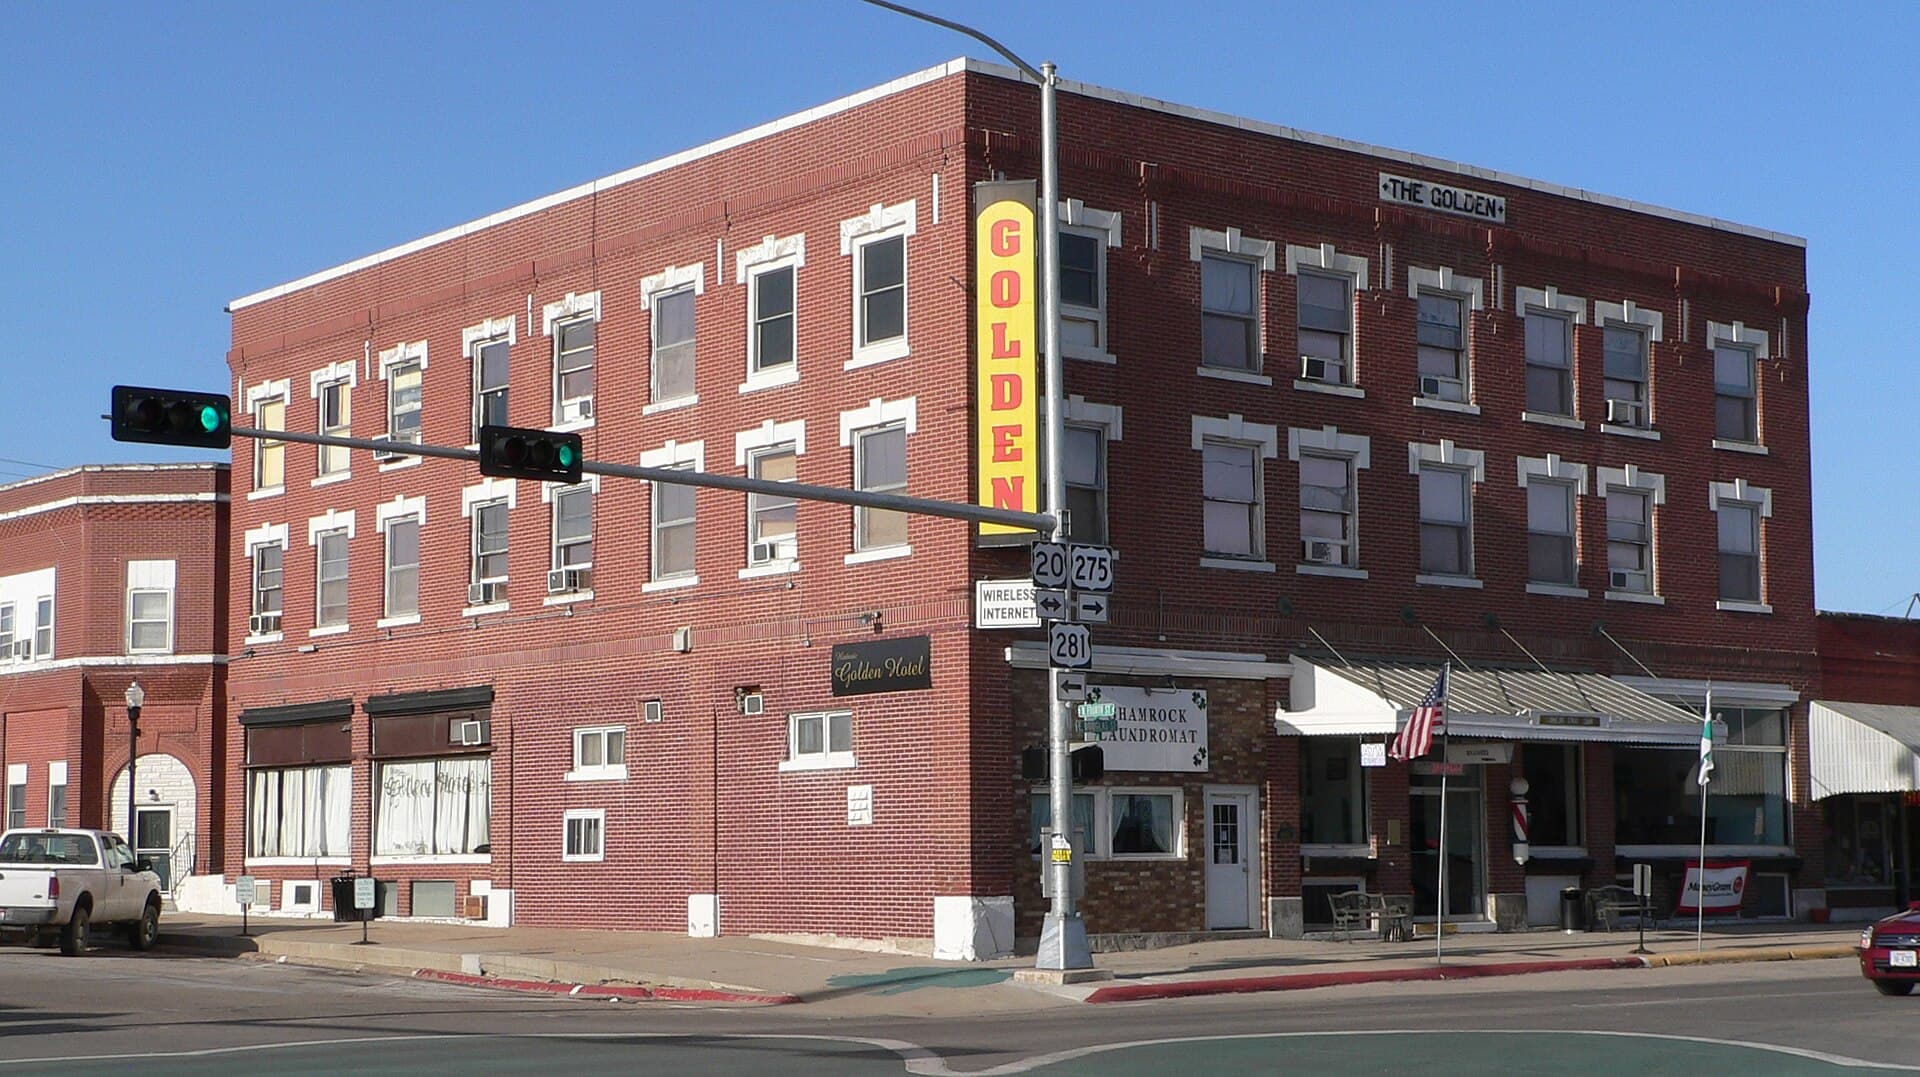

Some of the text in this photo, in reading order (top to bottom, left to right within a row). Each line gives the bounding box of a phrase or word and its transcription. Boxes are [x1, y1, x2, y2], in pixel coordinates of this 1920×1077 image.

[1389, 178, 1497, 218] THE GOLDEN
[990, 218, 1025, 513] GOLDEN
[1035, 550, 1064, 577] 20
[1075, 555, 1108, 582] 275
[982, 588, 1037, 602] WIRELESS
[982, 607, 1036, 620] INTERNET
[1056, 632, 1086, 659] 281
[835, 655, 925, 688] Golden Hotel
[1100, 728, 1198, 743] LAUNDROMAT
